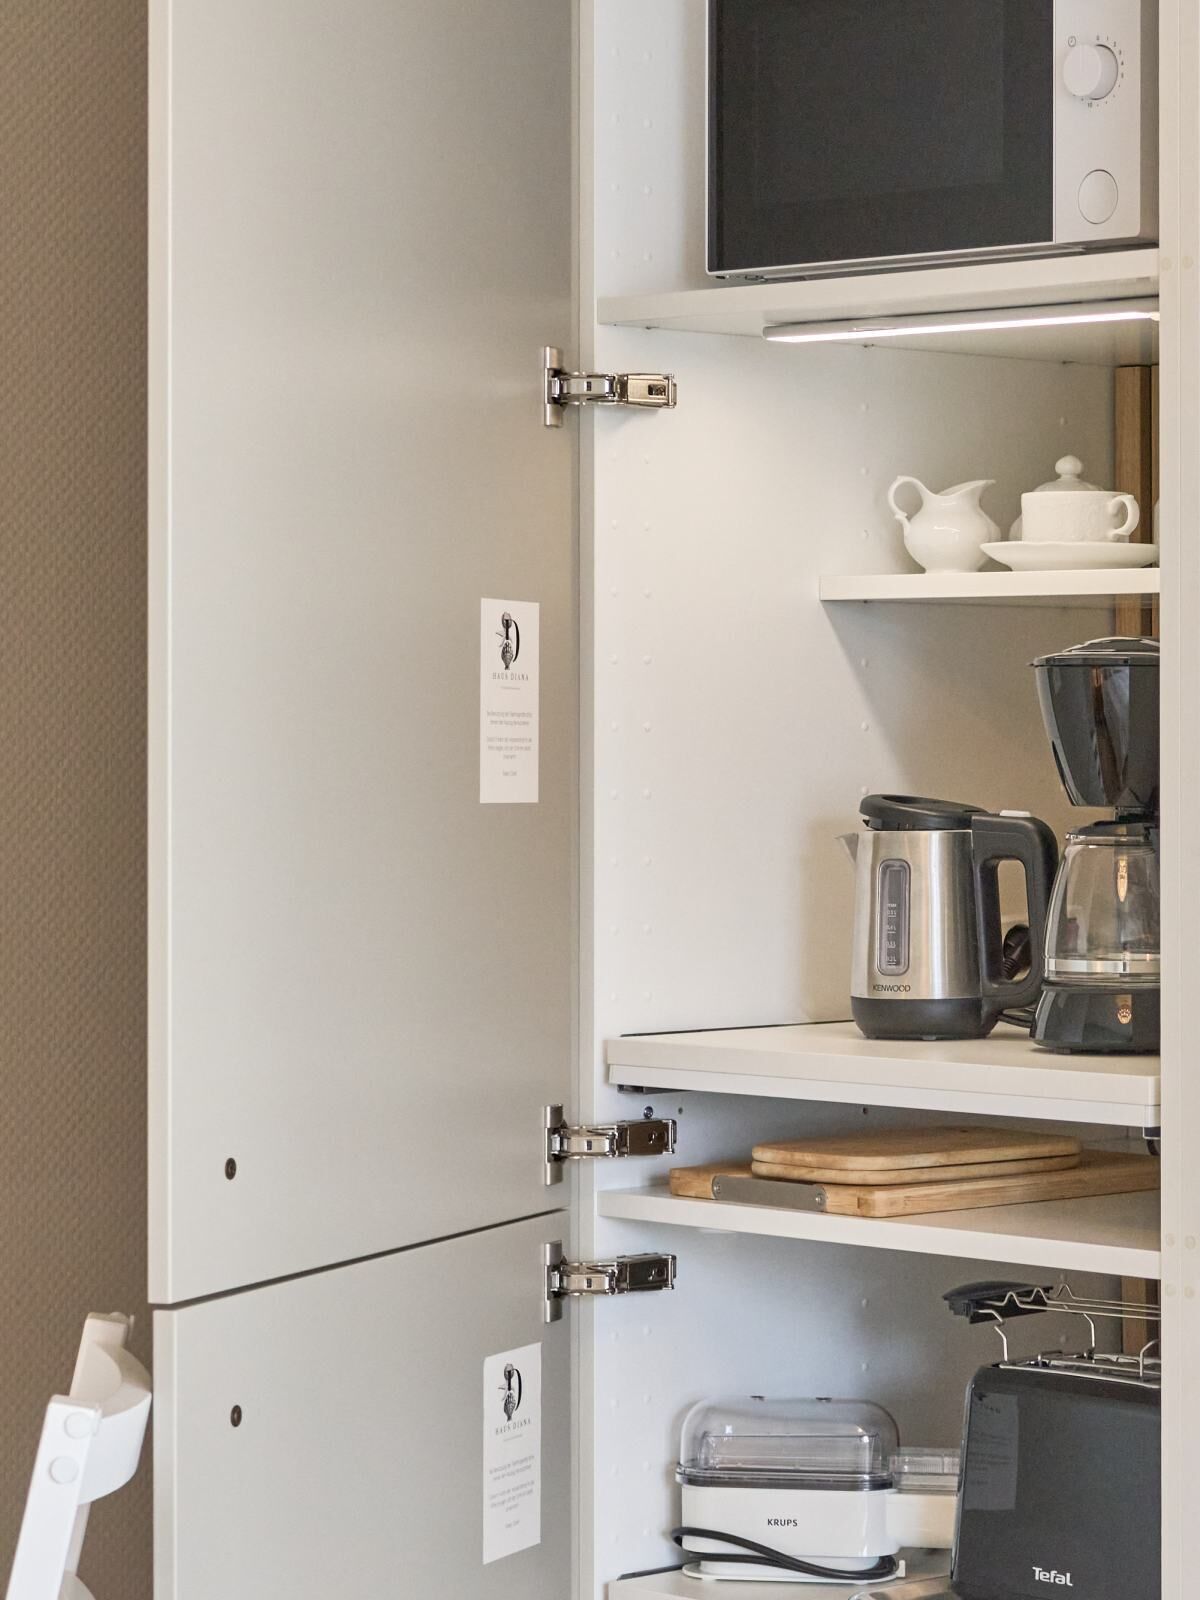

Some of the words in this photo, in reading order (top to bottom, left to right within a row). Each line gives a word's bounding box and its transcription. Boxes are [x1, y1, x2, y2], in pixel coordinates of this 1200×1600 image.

[872, 984, 911, 993] KENWOOD
[767, 1518, 798, 1527] KRUPS
[1032, 1566, 1073, 1587] Tefal
